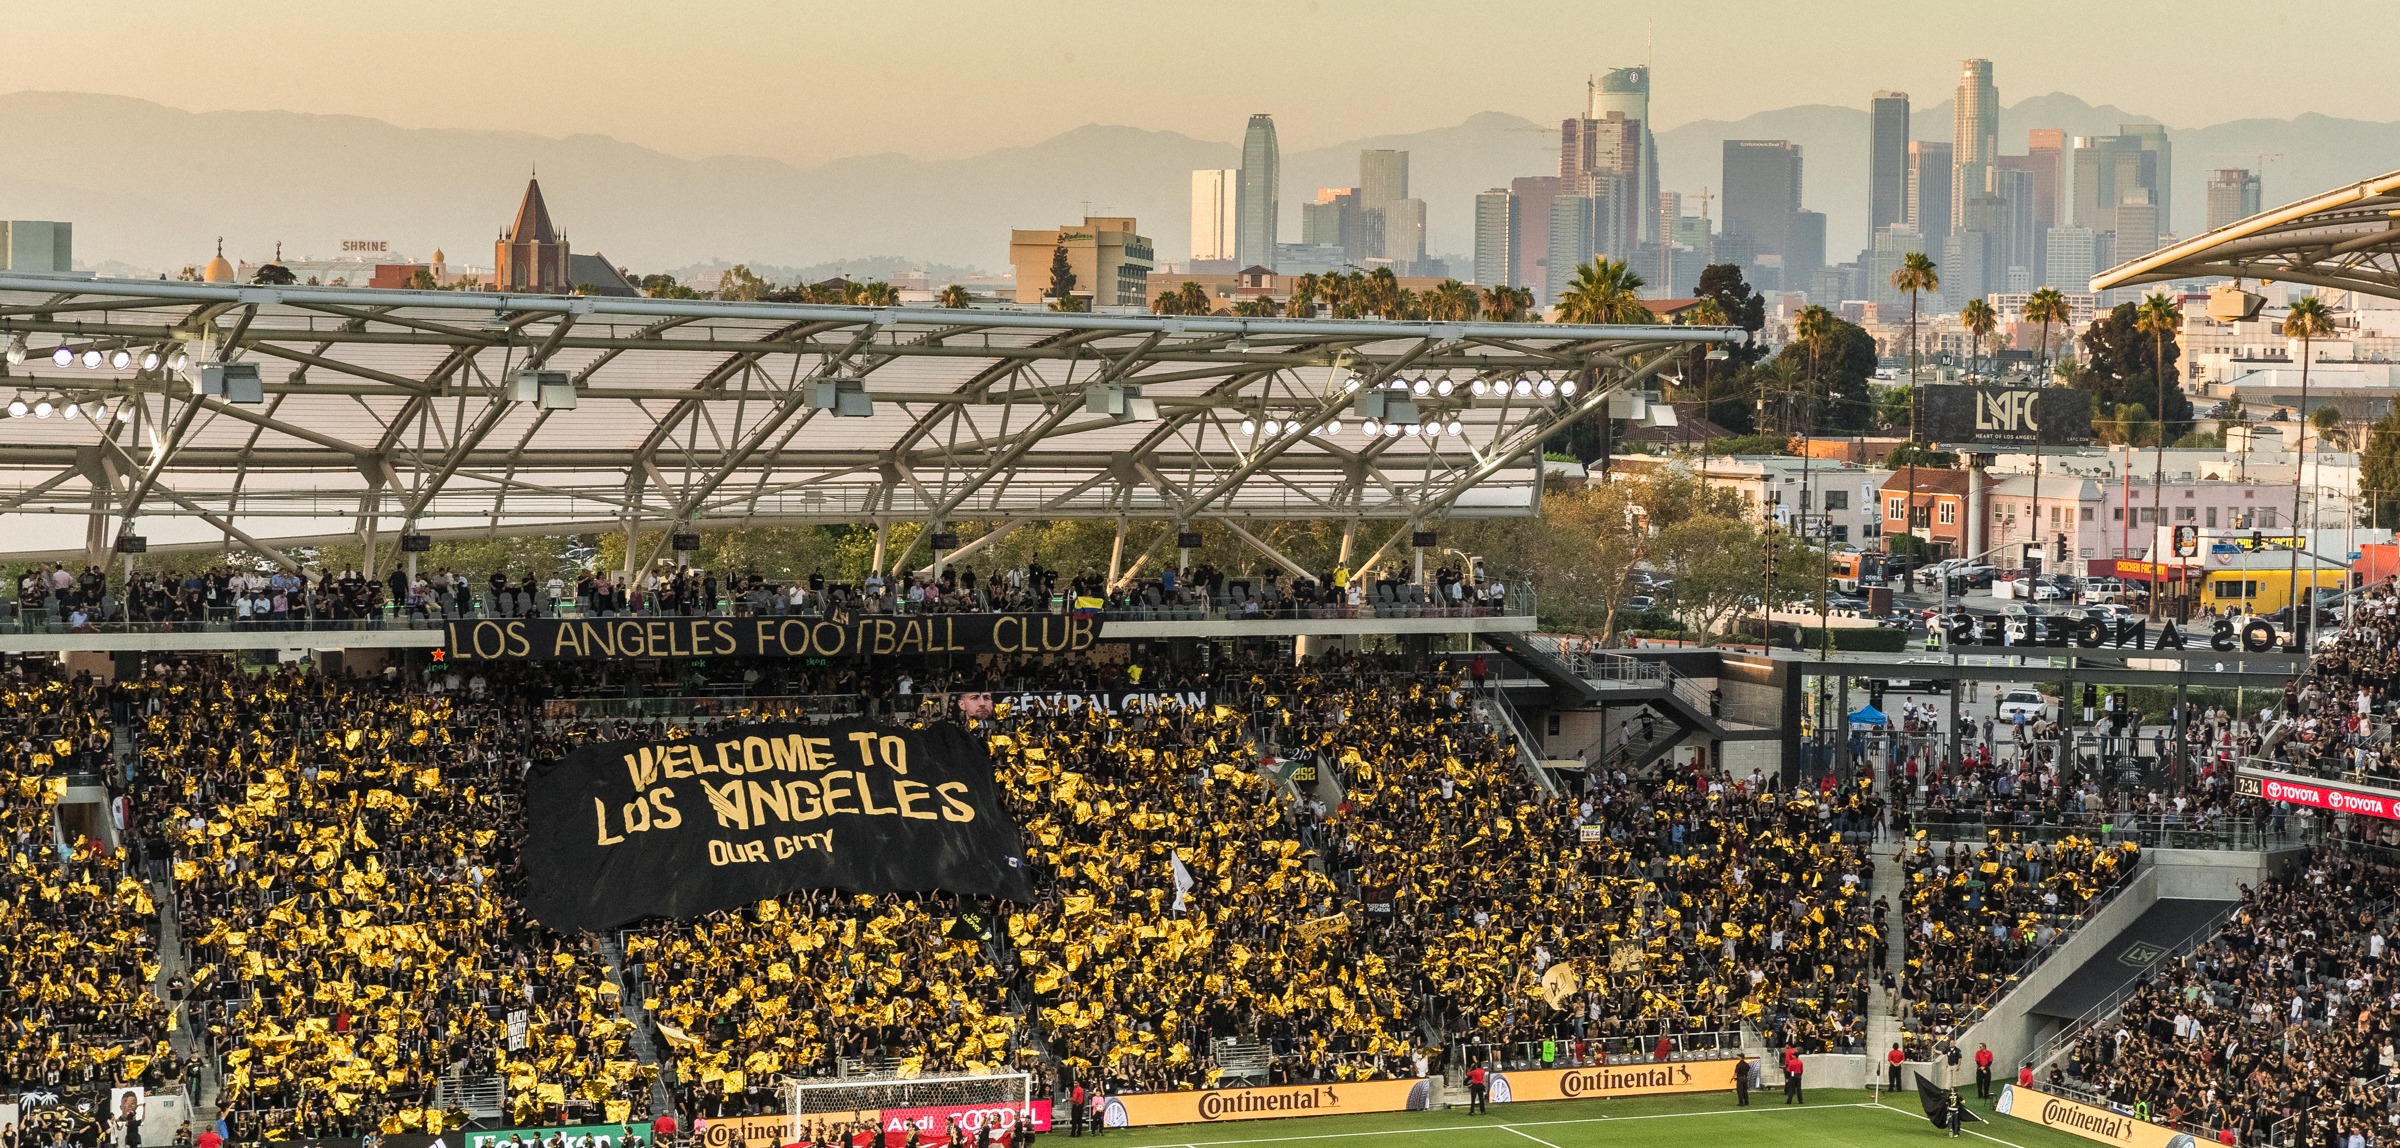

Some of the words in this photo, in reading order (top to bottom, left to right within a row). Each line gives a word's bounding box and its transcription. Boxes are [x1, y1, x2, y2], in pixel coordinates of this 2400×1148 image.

[342, 240, 387, 252] SHRINE
[2116, 560, 2141, 573] CHICKEN
[2141, 563, 2166, 576] FACRY
[449, 620, 531, 660] LOS
[554, 620, 737, 658] ANGELES
[756, 616, 965, 656] FOOTBALL
[993, 614, 1094, 653] CLUB
[624, 733, 837, 792] WELCOME
[848, 731, 907, 775] TO
[2239, 778, 2260, 795] 7:34
[2281, 785, 2320, 804] TOYOTA
[594, 786, 682, 846] LOS
[699, 769, 976, 831] ANGELES
[2343, 795, 2384, 814] TOYOTA
[708, 838, 771, 866] OUR
[774, 828, 834, 861] CITY
[1559, 1065, 1674, 1098] Continental
[1198, 1087, 1320, 1121] Continental
[2041, 1098, 2123, 1139] Continental
